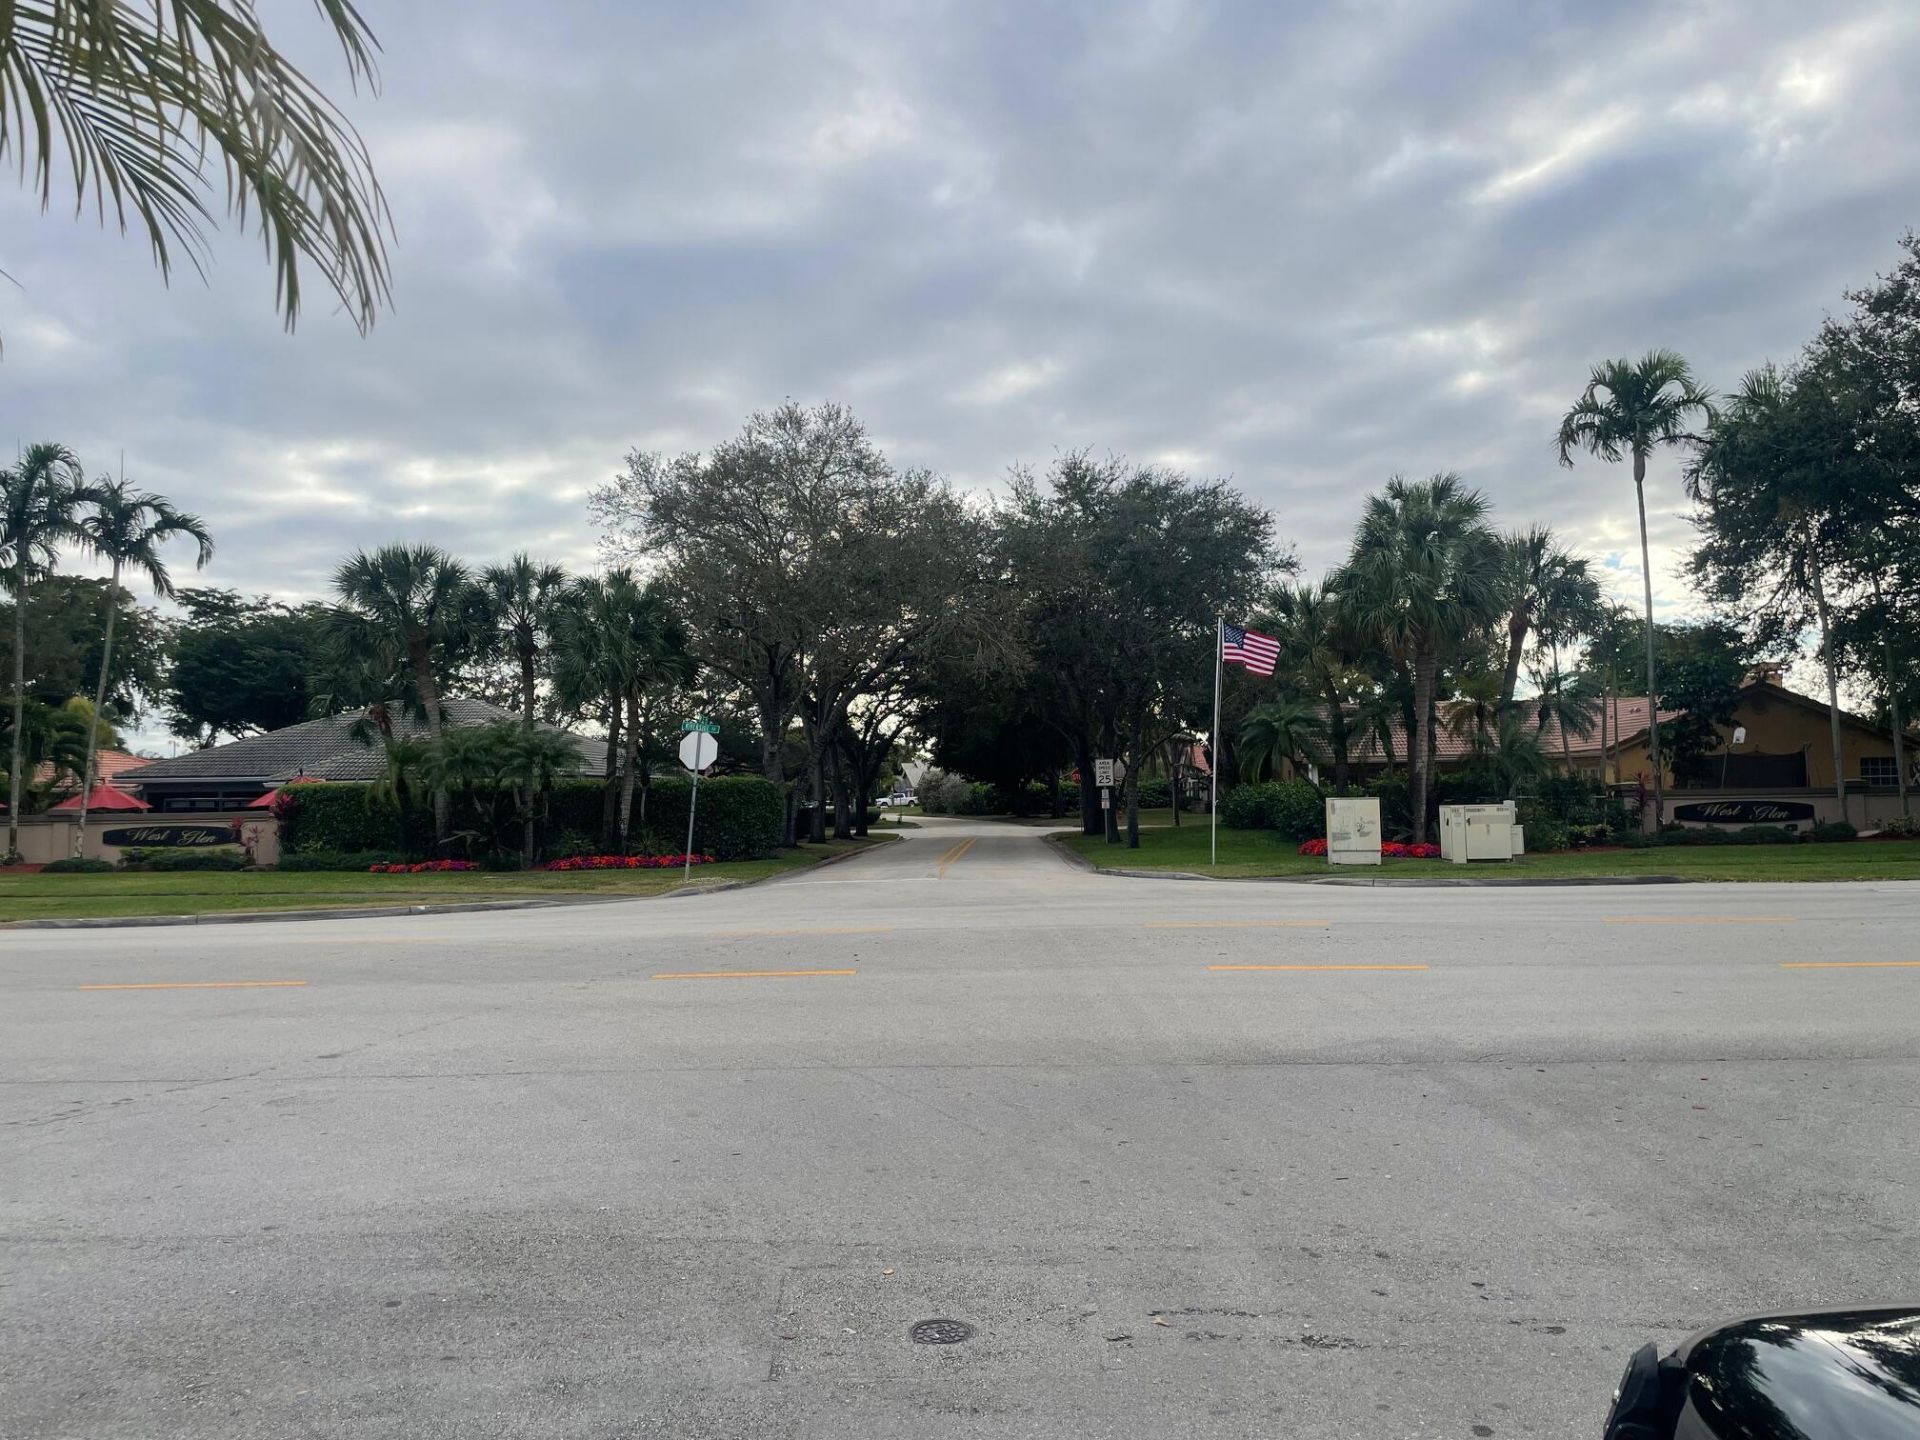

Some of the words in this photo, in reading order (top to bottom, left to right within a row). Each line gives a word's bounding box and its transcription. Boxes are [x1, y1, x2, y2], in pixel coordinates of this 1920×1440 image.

[1098, 775, 1111, 784] 25
[1697, 804, 1742, 816] West
[1749, 805, 1791, 819] Glen
[126, 828, 171, 841] West
[178, 830, 216, 845] Glen
